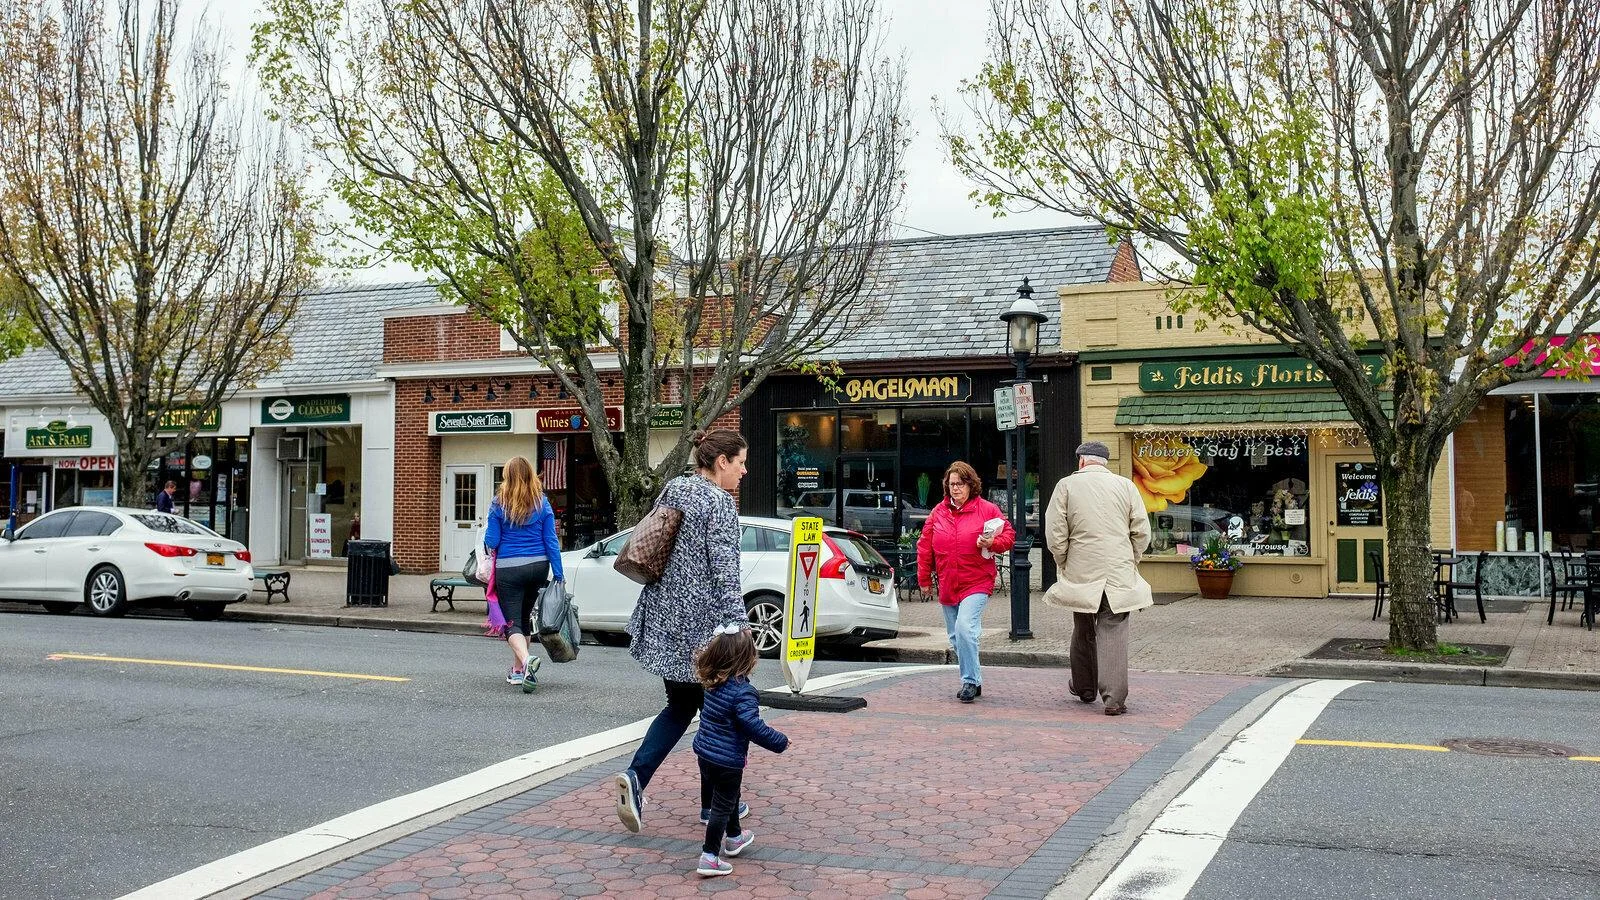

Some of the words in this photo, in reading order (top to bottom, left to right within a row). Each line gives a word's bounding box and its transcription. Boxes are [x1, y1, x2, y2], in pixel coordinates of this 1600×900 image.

[1173, 366, 1243, 390] Feldis
[1251, 362, 1333, 388] Floris
[846, 376, 958, 402] BAGELMAN
[298, 404, 343, 416] CLEANERS
[439, 414, 466, 428] Seventh
[467, 414, 486, 428] Street
[486, 414, 507, 426] Travel
[540, 416, 569, 428] Wines
[28, 434, 46, 446] ART
[48, 434, 56, 446] &
[60, 434, 88, 446] FRAME
[1138, 446, 1201, 458] Flowers
[1207, 445, 1239, 460] Say
[1244, 444, 1256, 457] It
[1263, 444, 1300, 457] Best
[58, 460, 76, 468] NOW
[80, 456, 115, 470] OPEN
[1338, 488, 1378, 502] feldis
[801, 522, 819, 530] STATE
[804, 532, 816, 542] LAW
